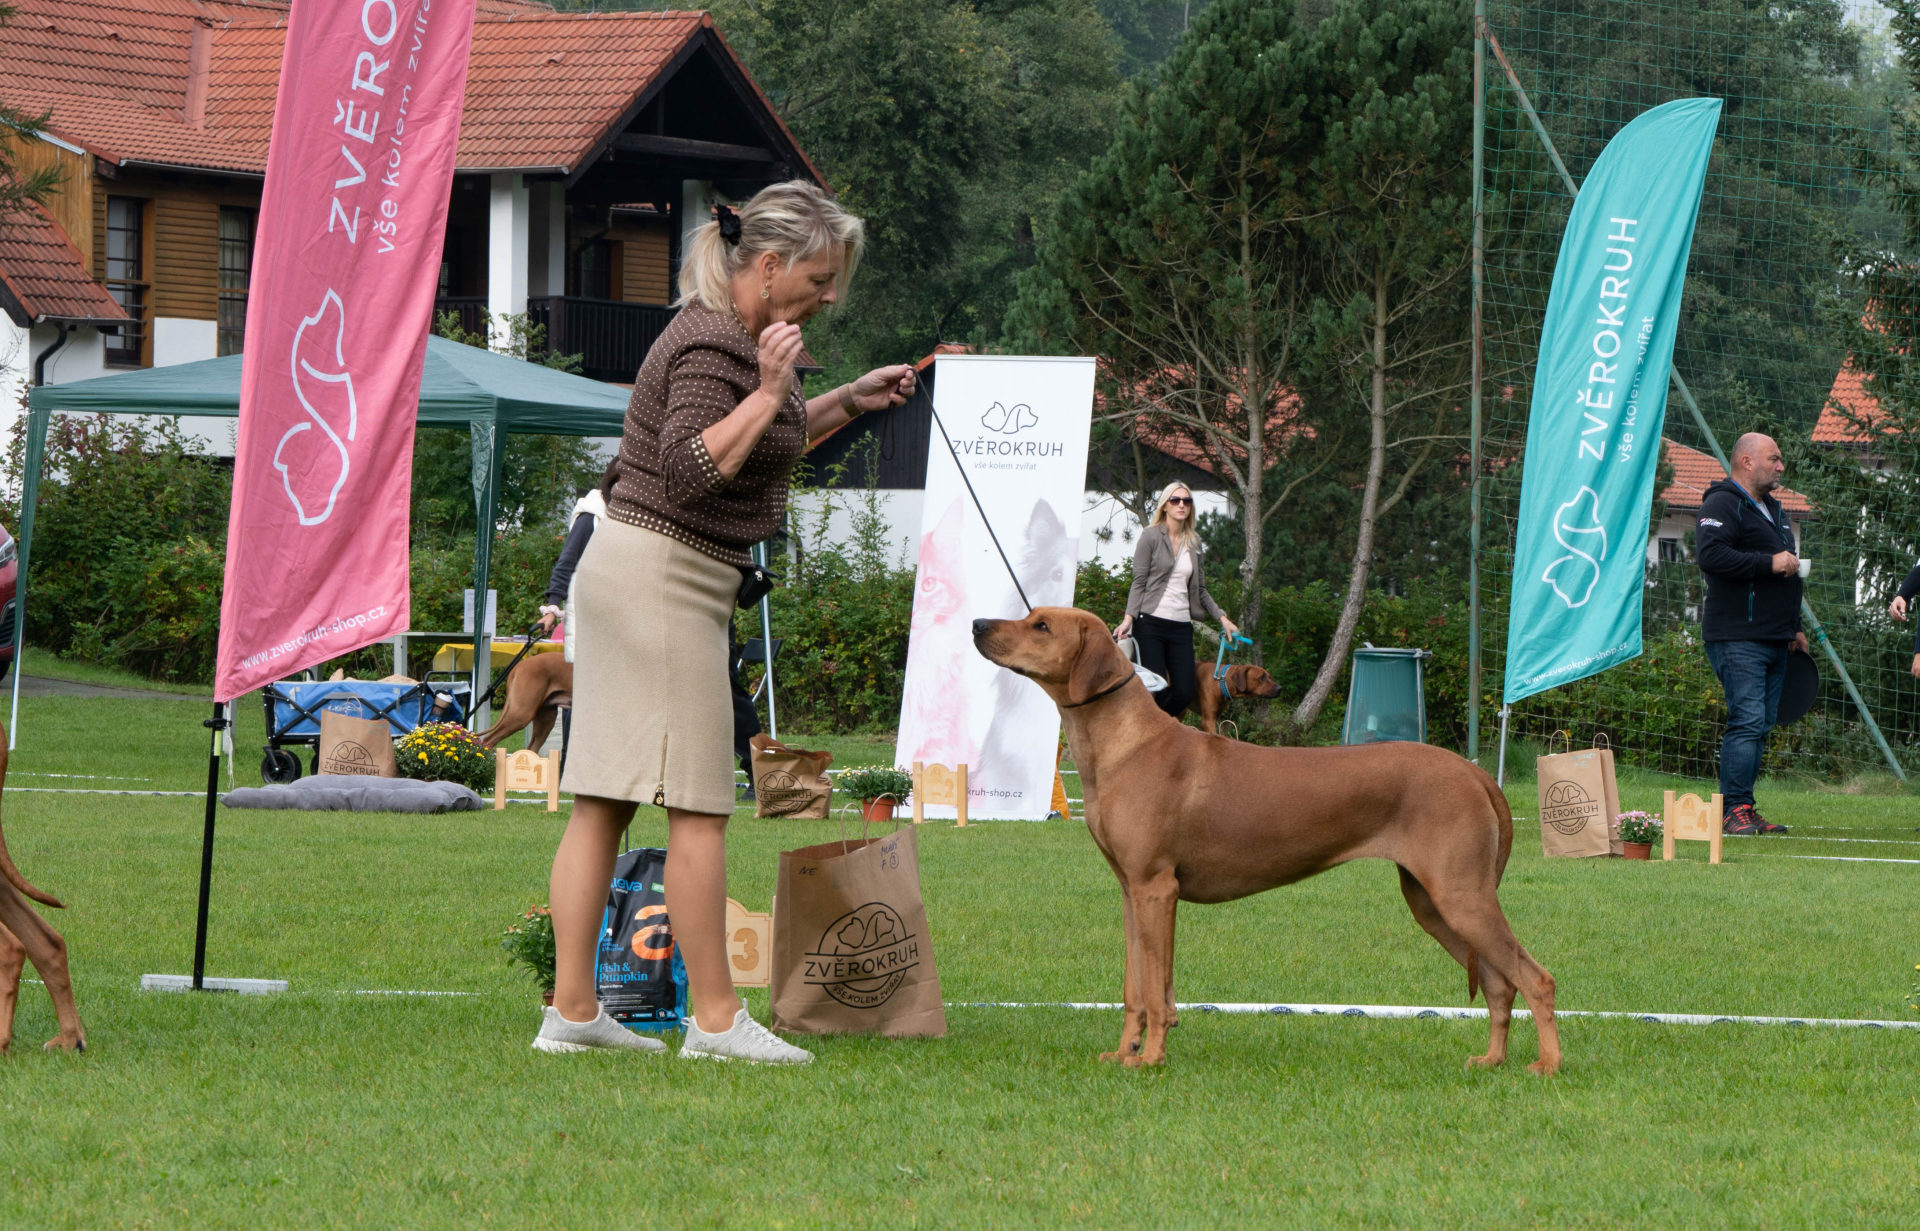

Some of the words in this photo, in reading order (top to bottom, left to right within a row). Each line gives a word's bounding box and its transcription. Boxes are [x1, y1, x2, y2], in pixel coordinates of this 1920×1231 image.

[329, 0, 397, 244] ZVĚRO
[381, 85, 412, 188] kolem
[373, 199, 398, 254] vše
[1576, 217, 1638, 461] ZVĚROKRUH
[1637, 316, 1655, 365] zvířat
[1622, 371, 1642, 427] kolem
[952, 436, 1063, 457] ZVĚROKRUH
[1618, 432, 1634, 463] vše
[974, 461, 987, 470] vše
[989, 461, 1013, 470] kolem
[1015, 462, 1037, 471] zvířat
[242, 605, 388, 671] www.zverokruh-shop.cz
[1523, 642, 1629, 685] www.zverokruh-shop.cz
[324, 761, 380, 776] ZVĚROKRUH
[533, 764, 543, 785] 1
[943, 778, 954, 798] 2
[967, 787, 1023, 799] kruh-shop.cz
[1542, 804, 1599, 821] ZVĚROKRUH
[1697, 810, 1708, 832] 4
[731, 927, 760, 972] 3
[804, 942, 919, 978] ZVĚROKRUH
[599, 971, 648, 984] Pumpkin
[600, 962, 620, 973] Fish
[622, 962, 631, 972] &
[847, 993, 879, 1004] KOLEM
